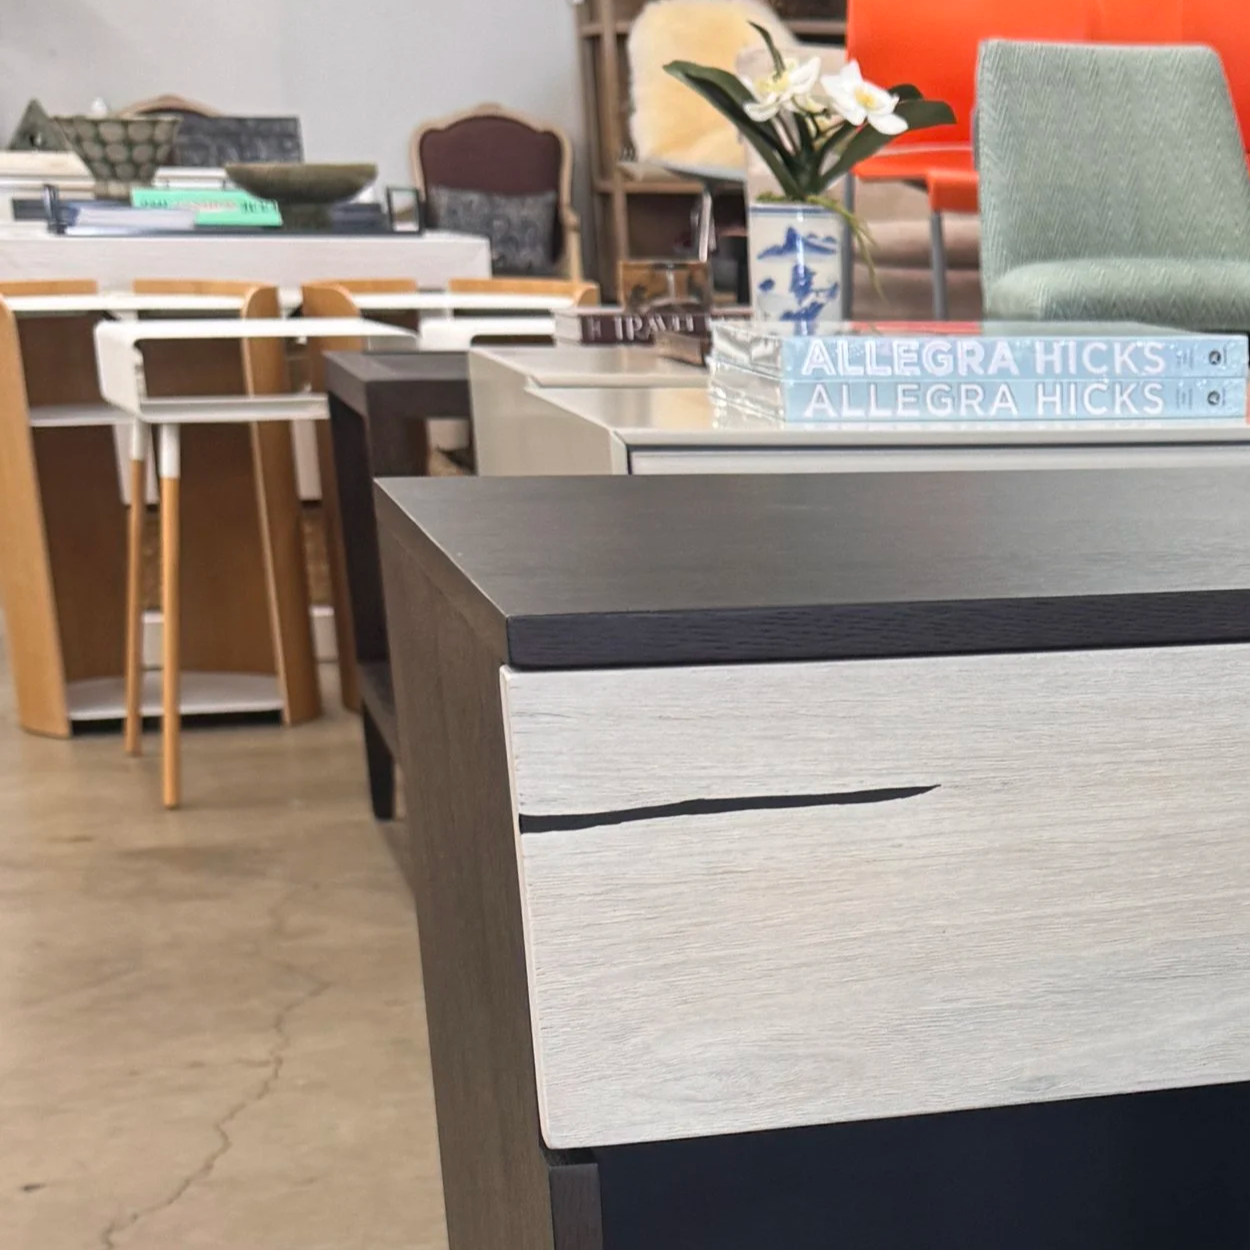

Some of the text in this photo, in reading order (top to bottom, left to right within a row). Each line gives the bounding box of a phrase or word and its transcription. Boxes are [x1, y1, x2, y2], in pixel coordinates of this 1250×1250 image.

[801, 338, 1020, 376] ALLEGRA
[1034, 340, 1166, 375] HICKS
[803, 383, 1019, 418] ALLEGRA
[1036, 382, 1165, 416] HICKS
